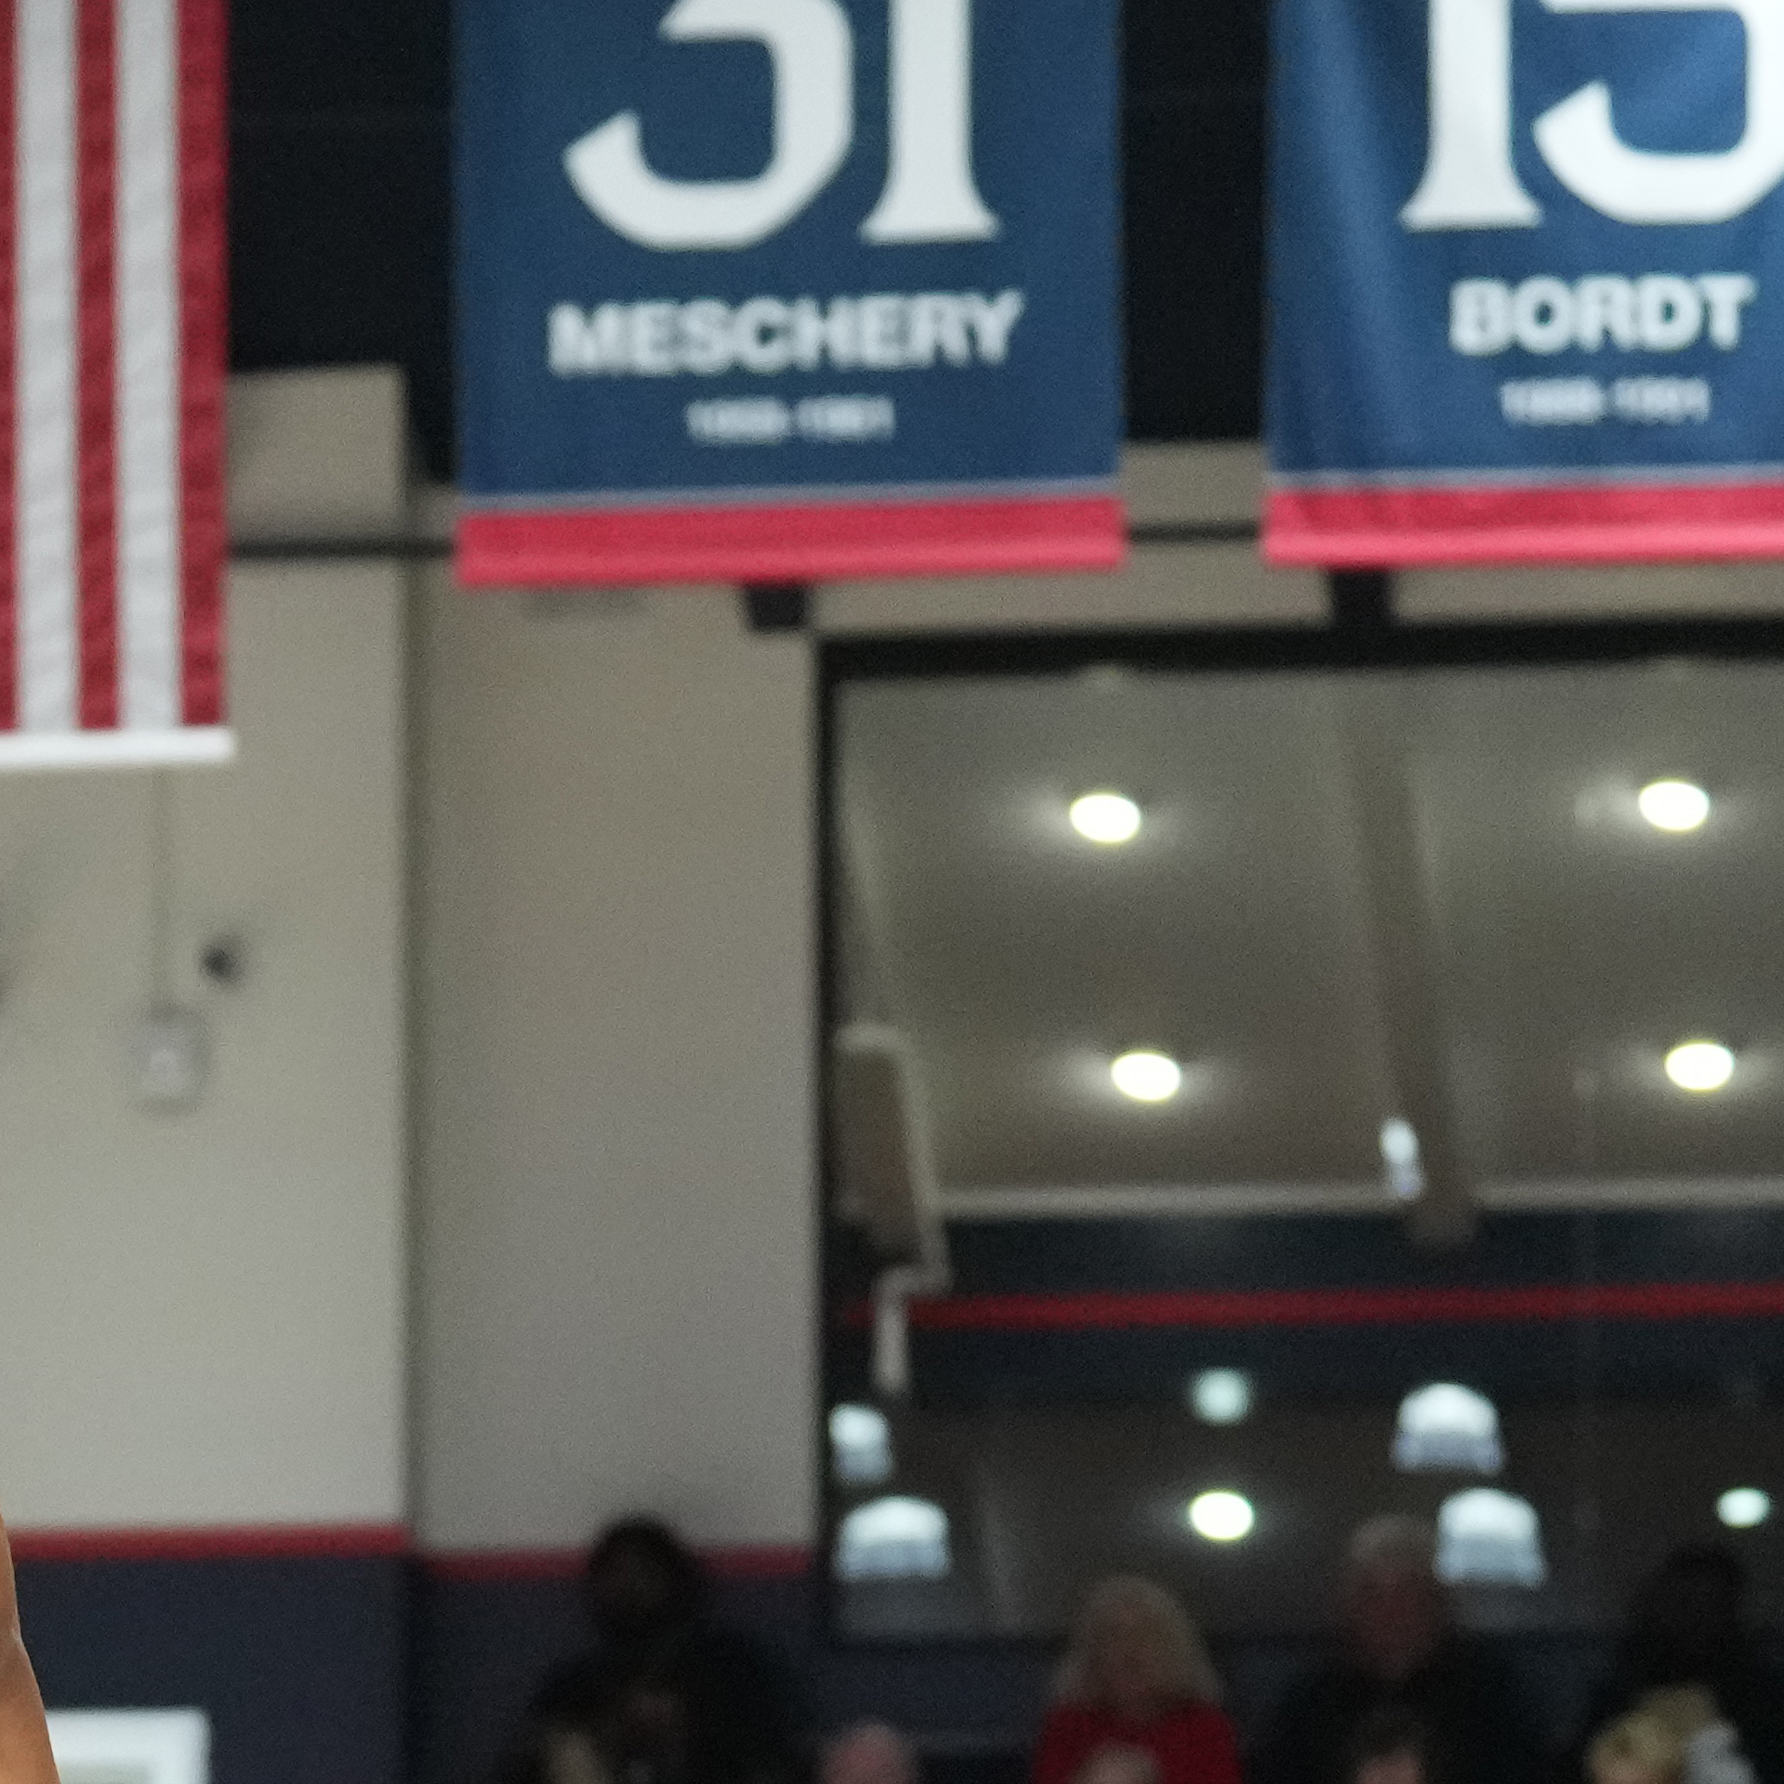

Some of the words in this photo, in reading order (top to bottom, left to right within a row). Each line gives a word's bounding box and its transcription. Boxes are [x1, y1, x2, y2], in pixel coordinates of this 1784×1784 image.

[562, 0, 1001, 252] 31
[546, 290, 1024, 378] MESCHERY
[1449, 272, 1758, 358] BORDT
